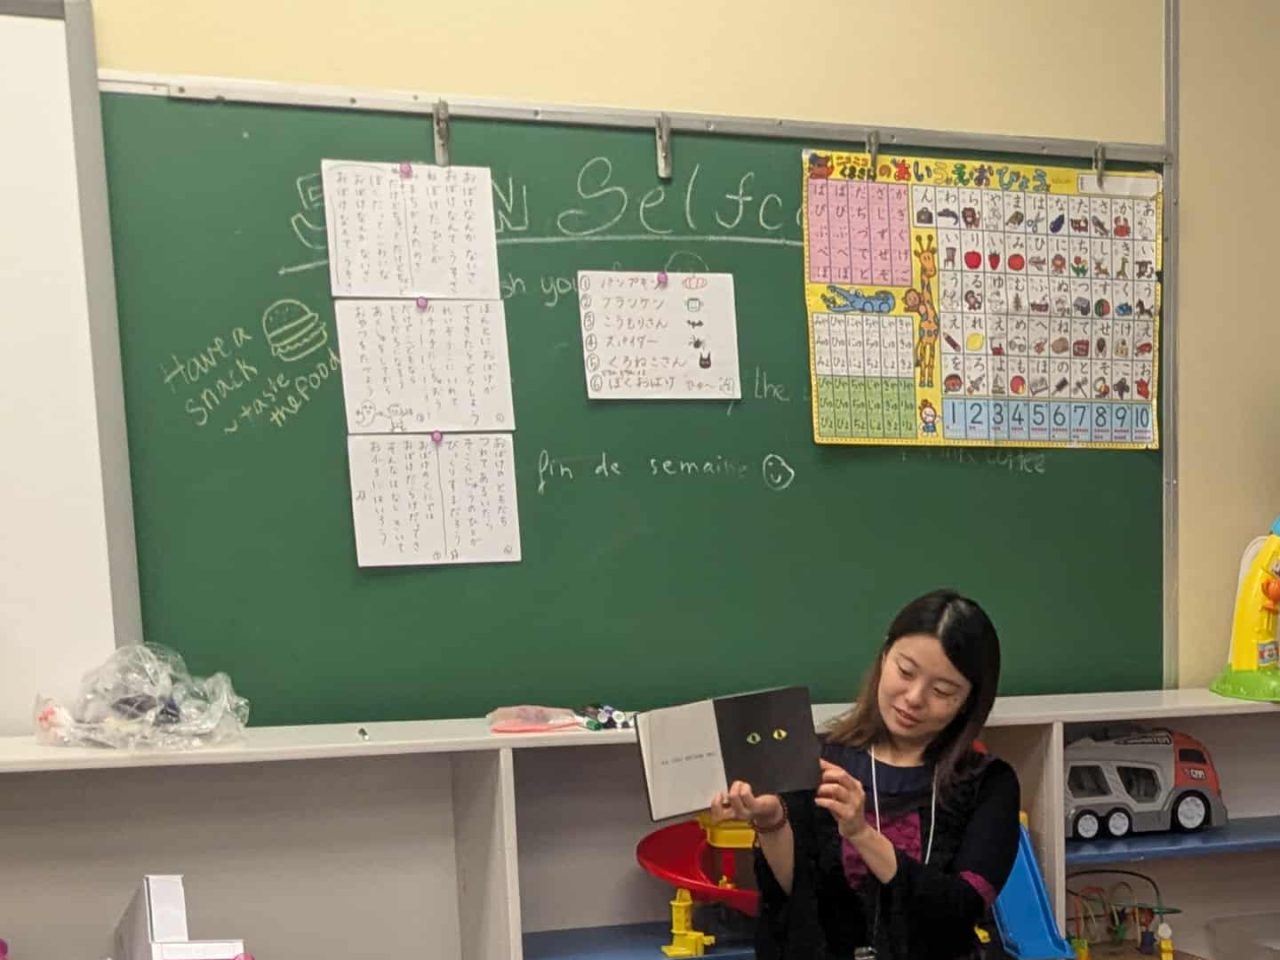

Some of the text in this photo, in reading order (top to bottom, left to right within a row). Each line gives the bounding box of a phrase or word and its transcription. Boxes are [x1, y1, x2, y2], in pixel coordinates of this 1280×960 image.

[160, 327, 252, 395] Have a
[951, 401, 1150, 428] 1 2 3 4 5 6 7 8 9 10
[538, 450, 573, 495] fin
[595, 452, 621, 478] de
